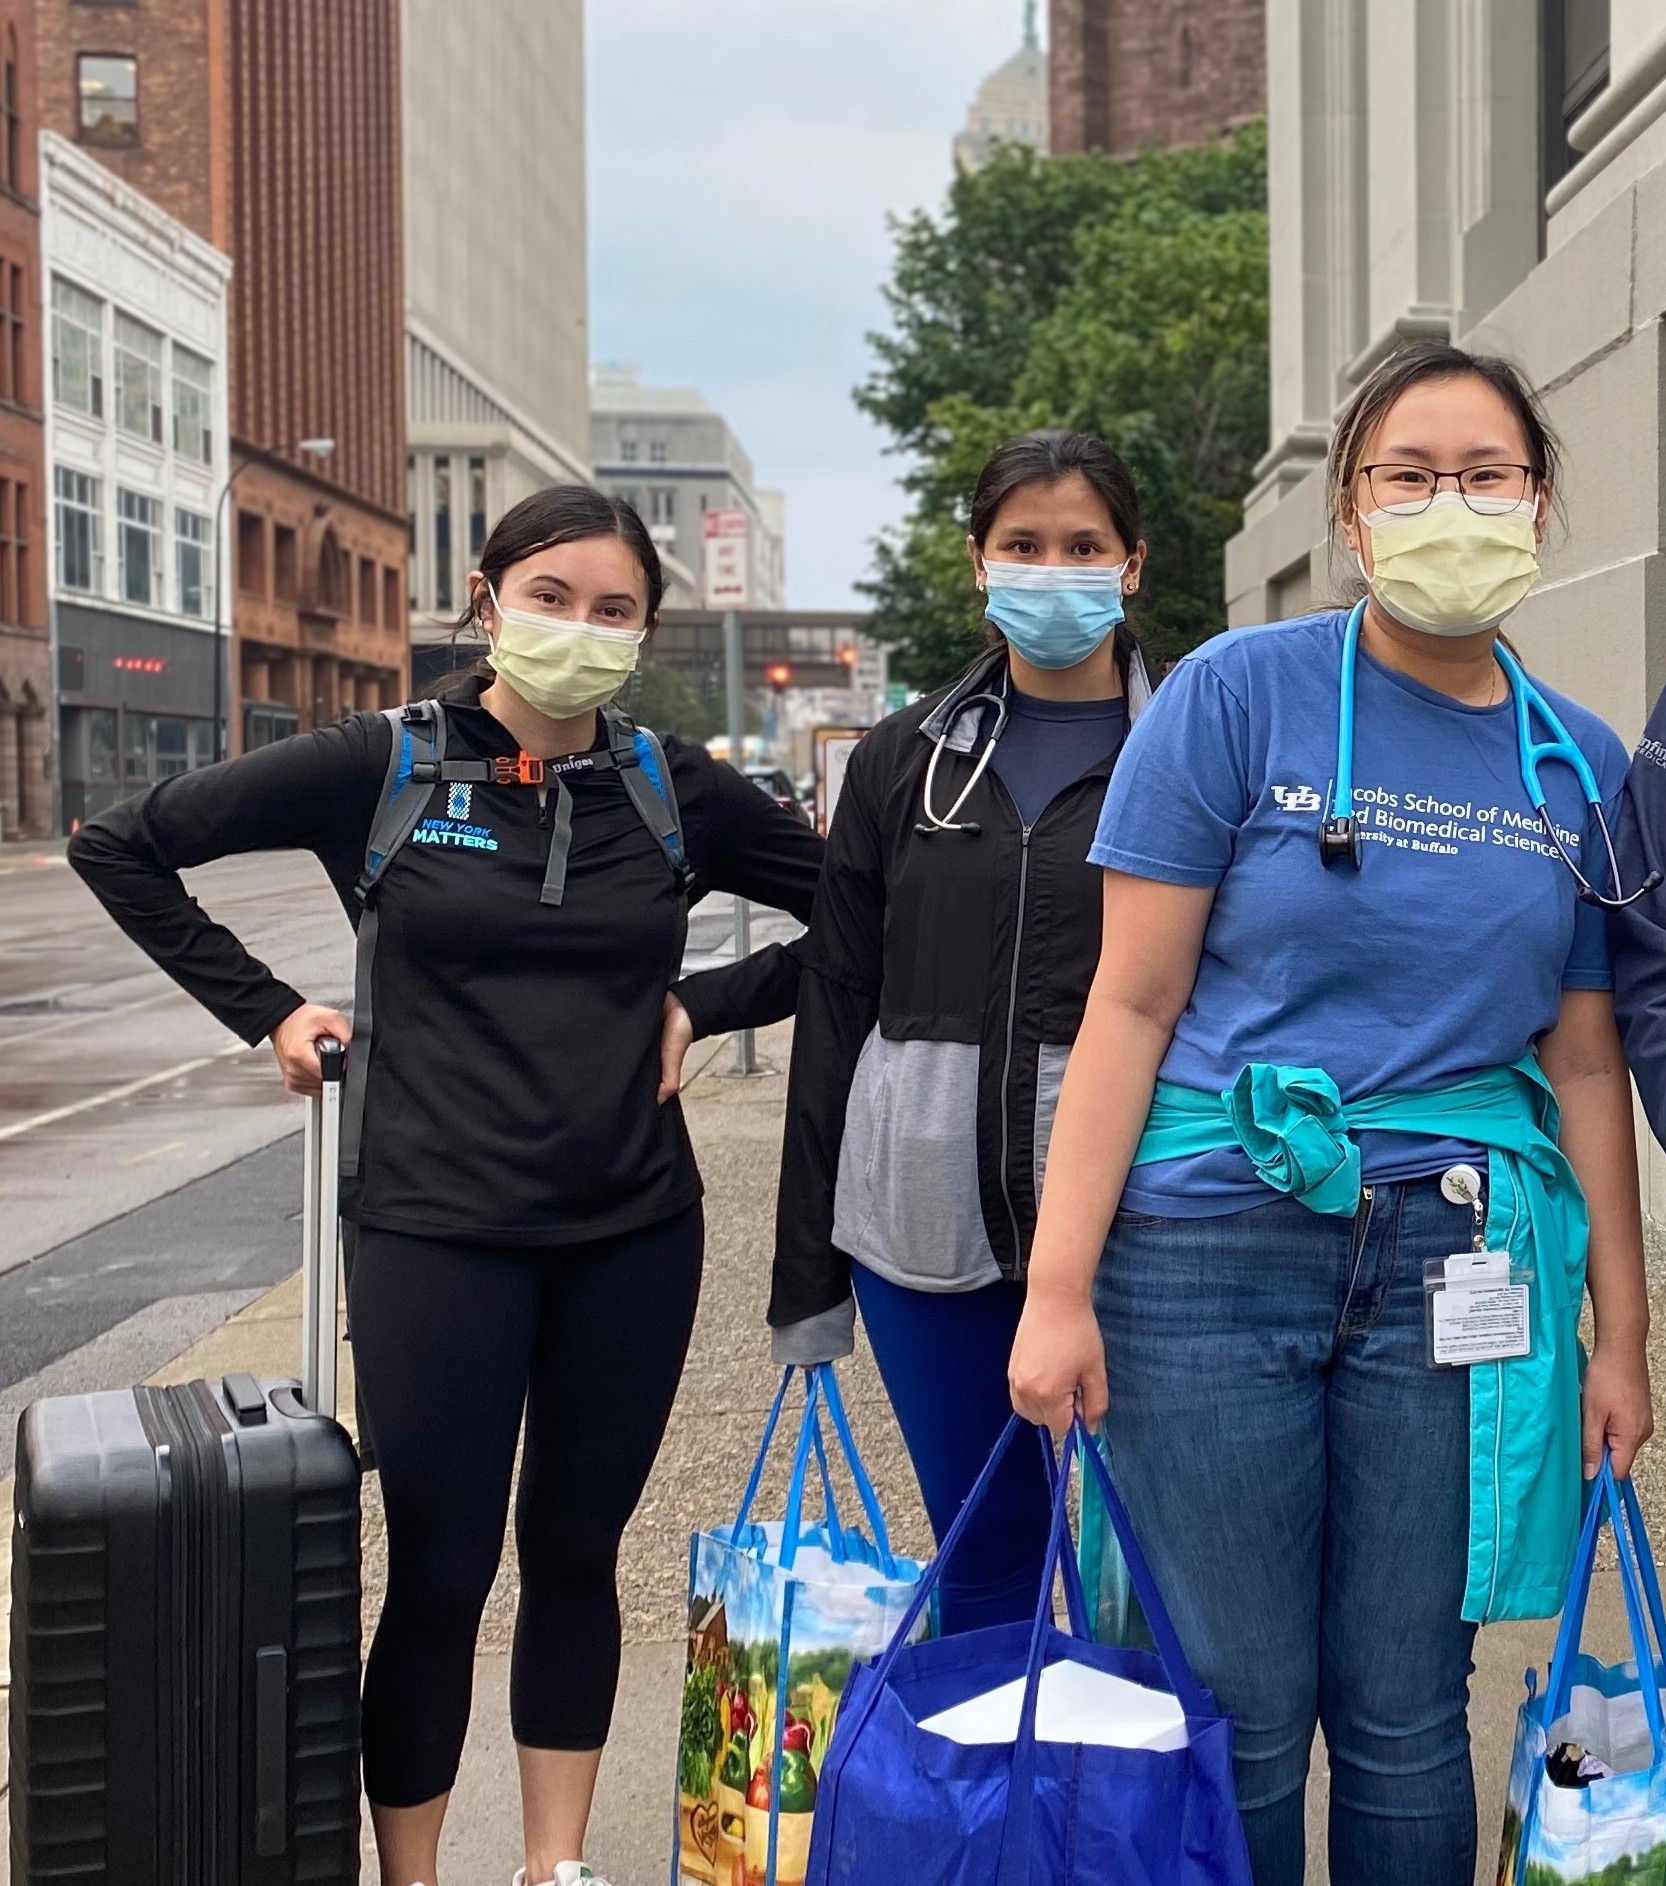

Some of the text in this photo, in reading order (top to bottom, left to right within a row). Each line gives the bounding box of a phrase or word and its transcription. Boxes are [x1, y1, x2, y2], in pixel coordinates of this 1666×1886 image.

[1270, 785, 1321, 811] UB
[421, 818, 492, 838] NEW YORK
[1403, 793, 1472, 819] School
[1476, 806, 1499, 823] of
[1502, 809, 1579, 847] Medine
[412, 828, 499, 851] MATTERS
[1375, 808, 1486, 843] Biomedical
[1492, 829, 1564, 861] Science
[1396, 838, 1409, 849] at
[1411, 839, 1459, 855] Buffalo
